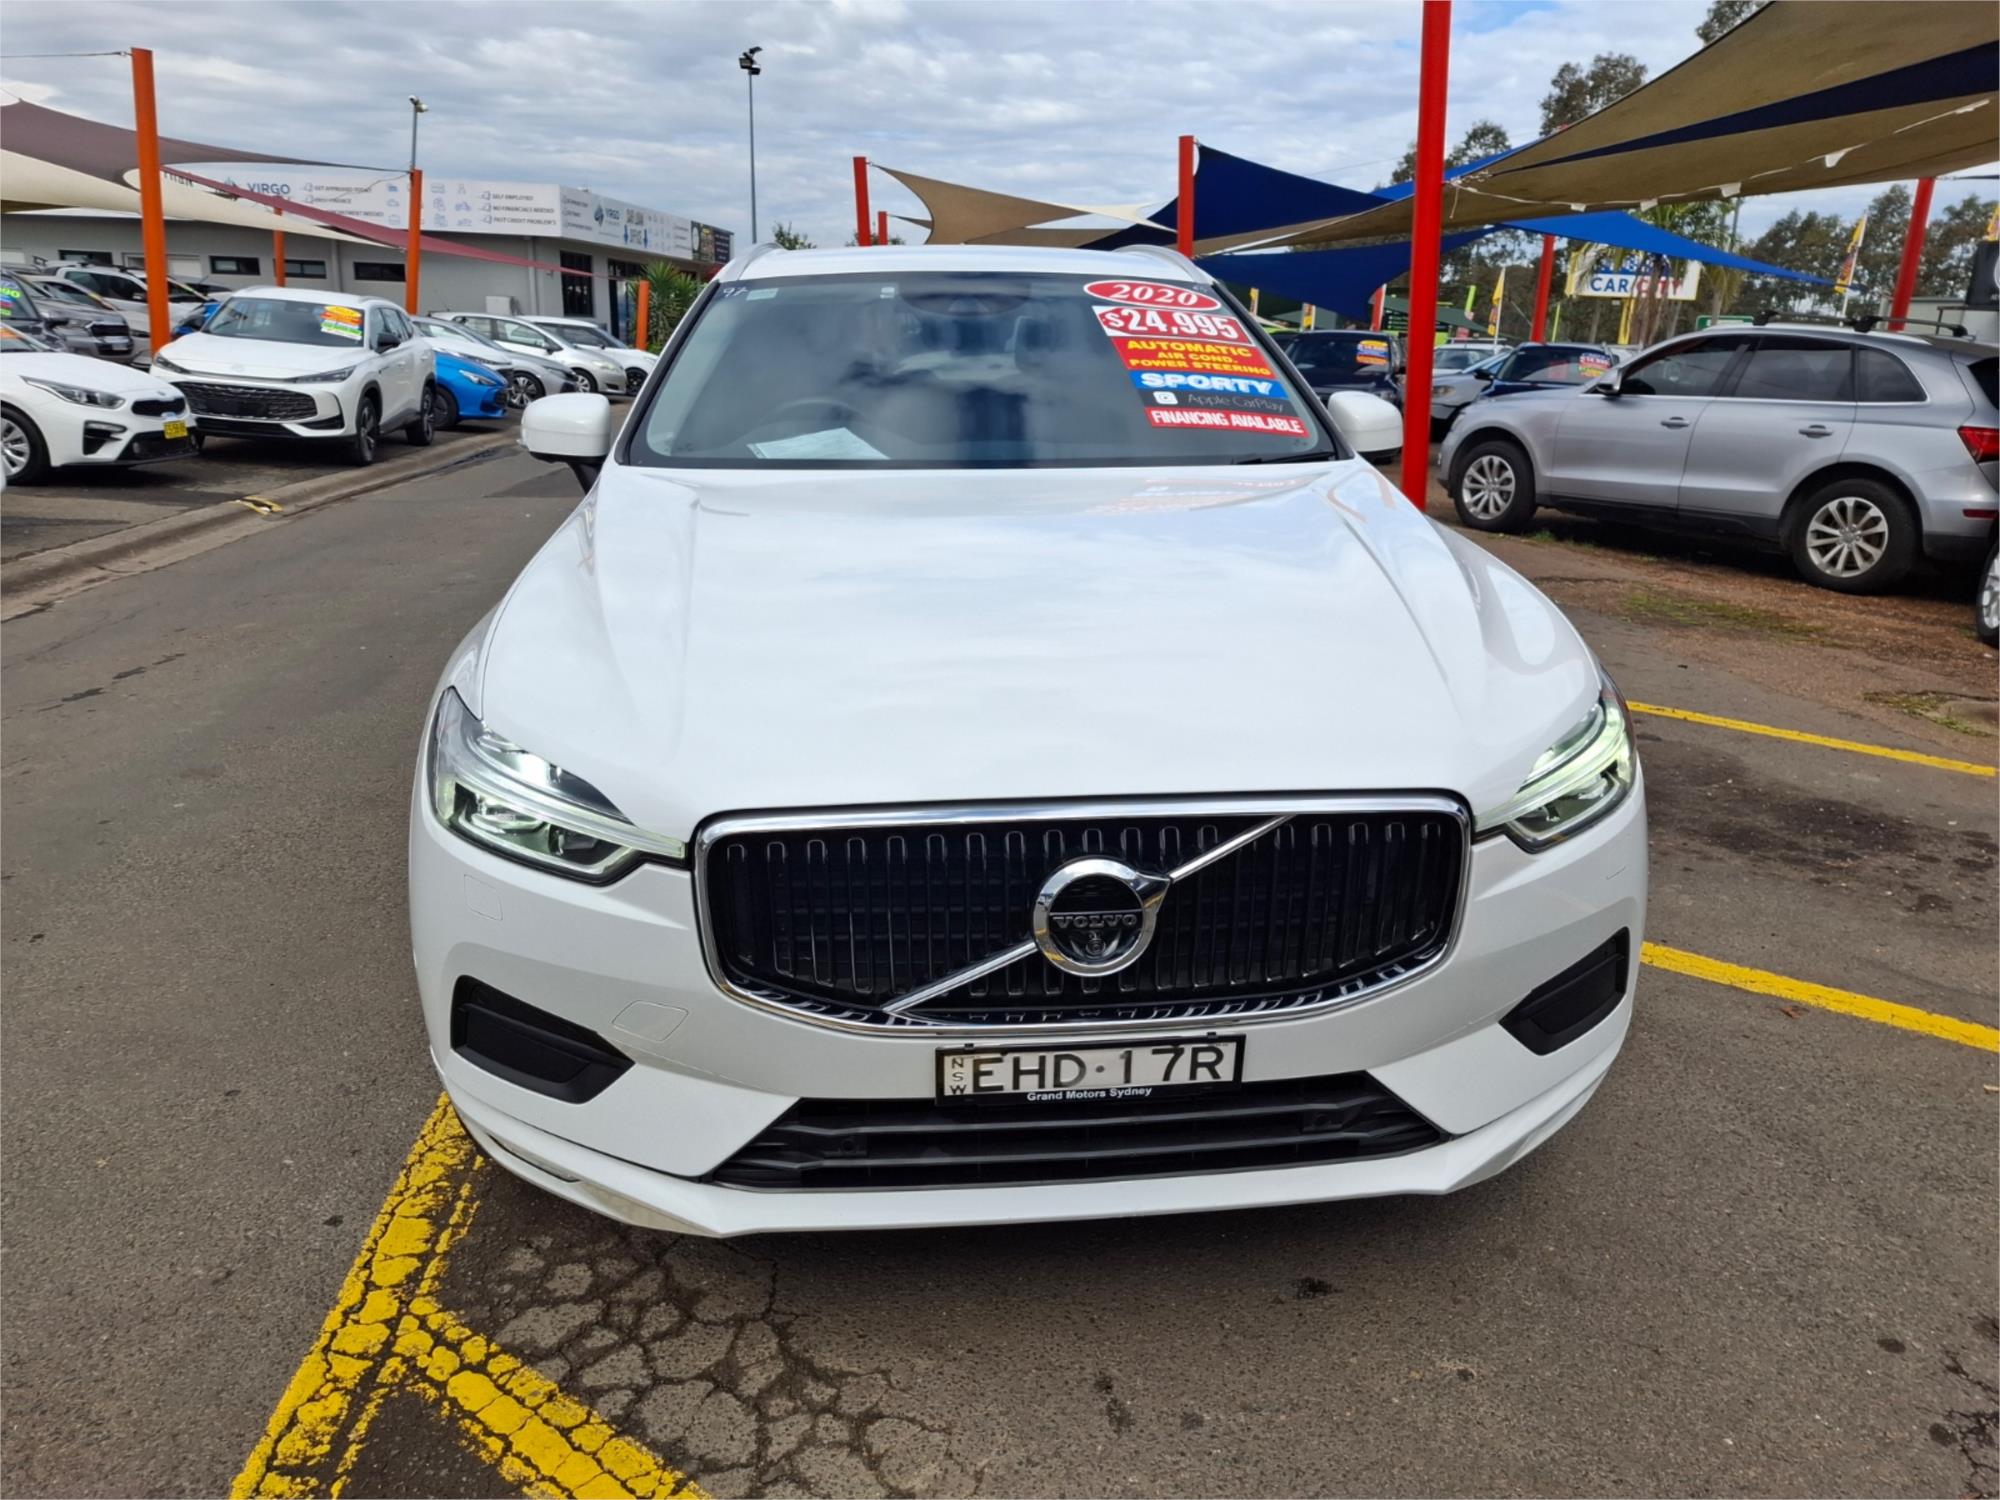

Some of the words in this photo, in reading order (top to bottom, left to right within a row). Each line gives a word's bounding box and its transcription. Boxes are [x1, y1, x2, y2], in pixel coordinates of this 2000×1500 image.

[248, 183, 290, 195] VIRGO
[1590, 277, 1629, 293] CAR
[1109, 284, 1198, 306] 2020
[1104, 308, 1239, 339] $24,995
[1127, 340, 1253, 357] AUTOMATIC
[1157, 352, 1185, 360] AIR
[1188, 352, 1239, 364] COND.
[1129, 359, 1189, 369] POWER
[1192, 361, 1272, 376] STEERING
[1140, 373, 1273, 396] SPORTY
[1188, 394, 1231, 408] Apple
[1232, 396, 1284, 413] CarPlay
[1151, 410, 1228, 427] FINANCING
[1231, 413, 1304, 434] AVAILABLE
[1052, 914, 1138, 929] VOLVO
[1027, 1091, 1063, 1101] Grand
[1065, 1089, 1106, 1100] Motors
[1109, 1087, 1153, 1099] Sydney
